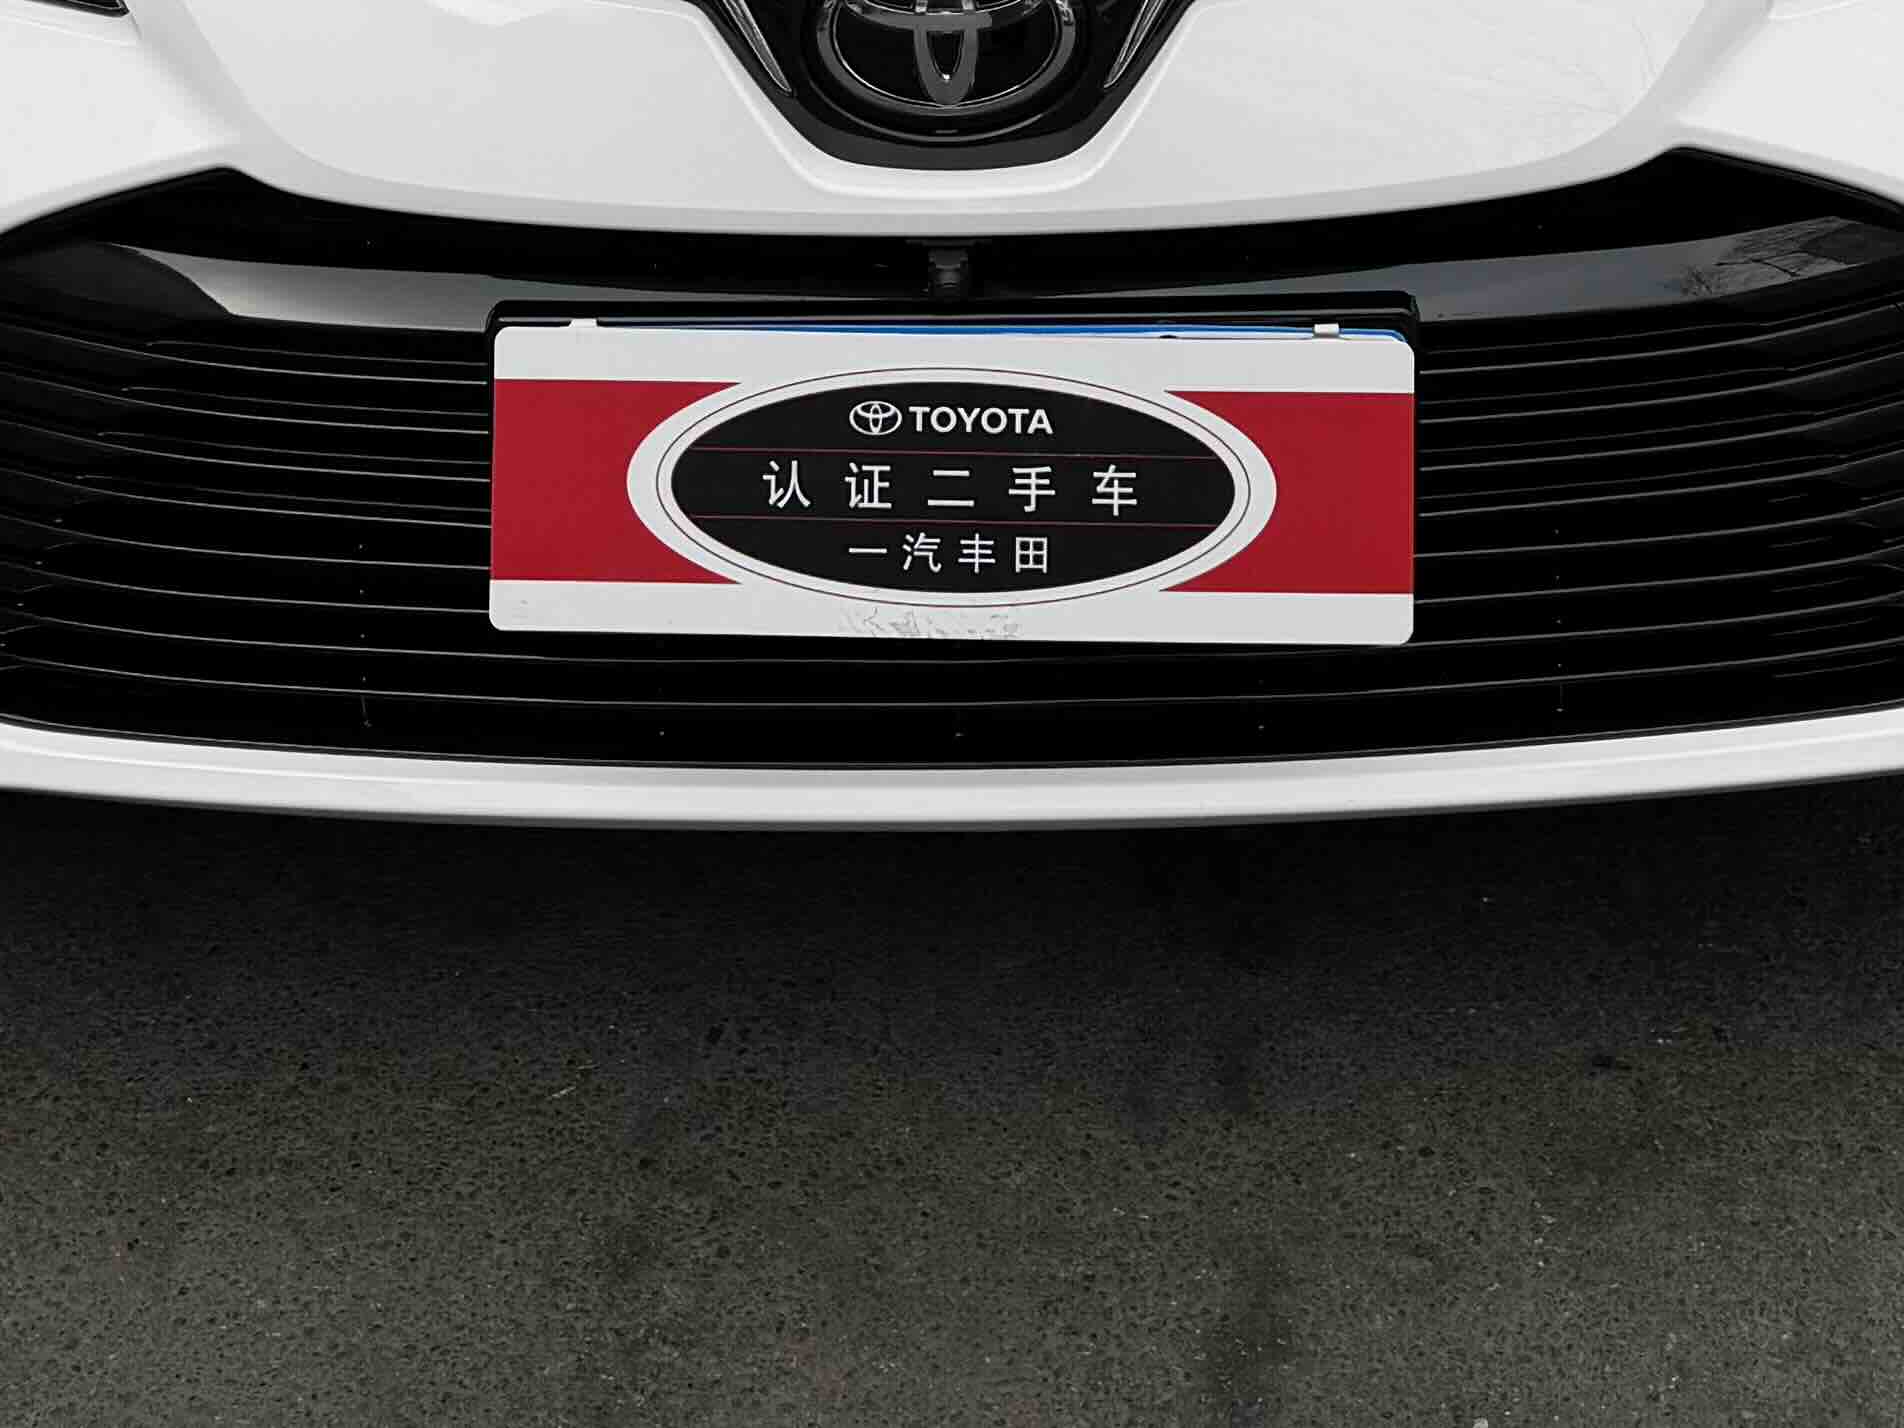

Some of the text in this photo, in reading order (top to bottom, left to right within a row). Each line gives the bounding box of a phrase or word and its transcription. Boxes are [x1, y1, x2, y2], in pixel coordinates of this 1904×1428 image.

[907, 405, 1054, 437] TOYOTA
[761, 461, 1139, 517] 认证二手车
[847, 532, 1051, 576] 一汽丰田
